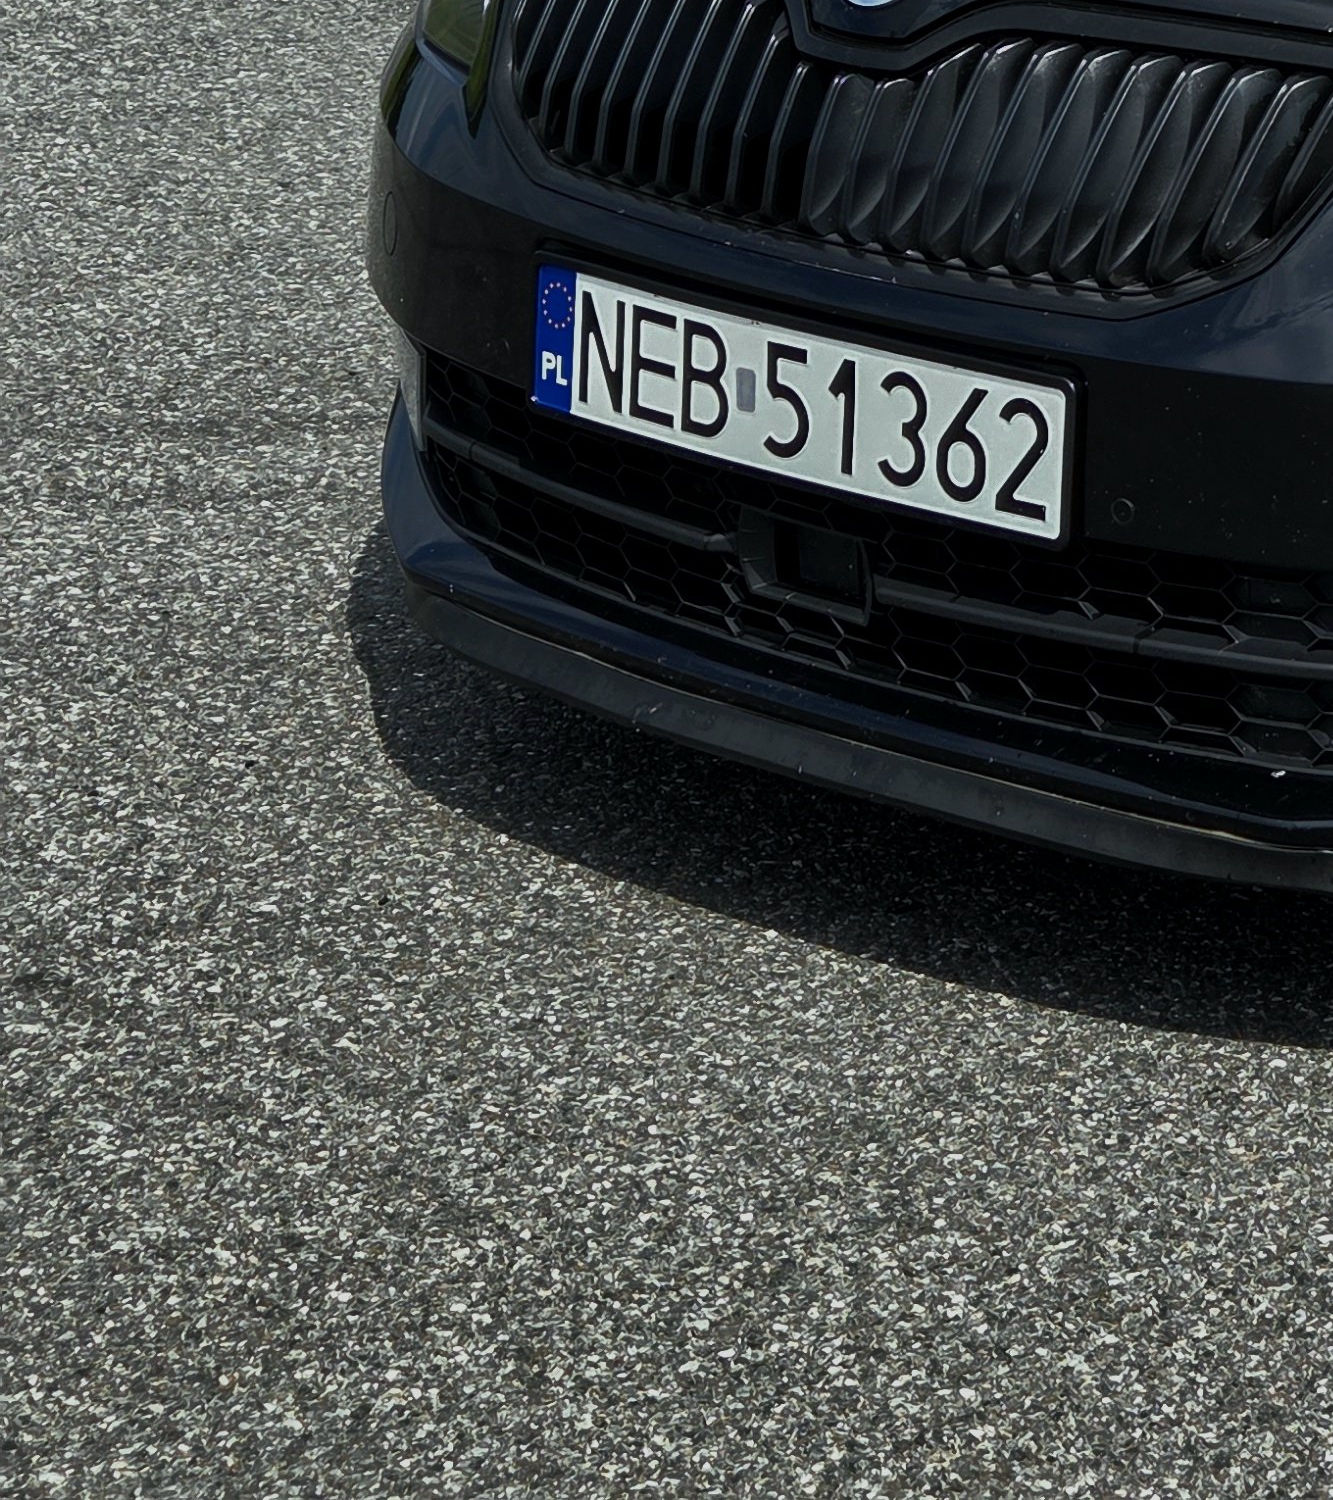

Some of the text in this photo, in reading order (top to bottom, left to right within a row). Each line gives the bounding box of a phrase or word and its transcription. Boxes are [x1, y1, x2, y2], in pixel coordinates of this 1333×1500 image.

[541, 350, 568, 386] PL
[579, 290, 1049, 522] NEB 51362
